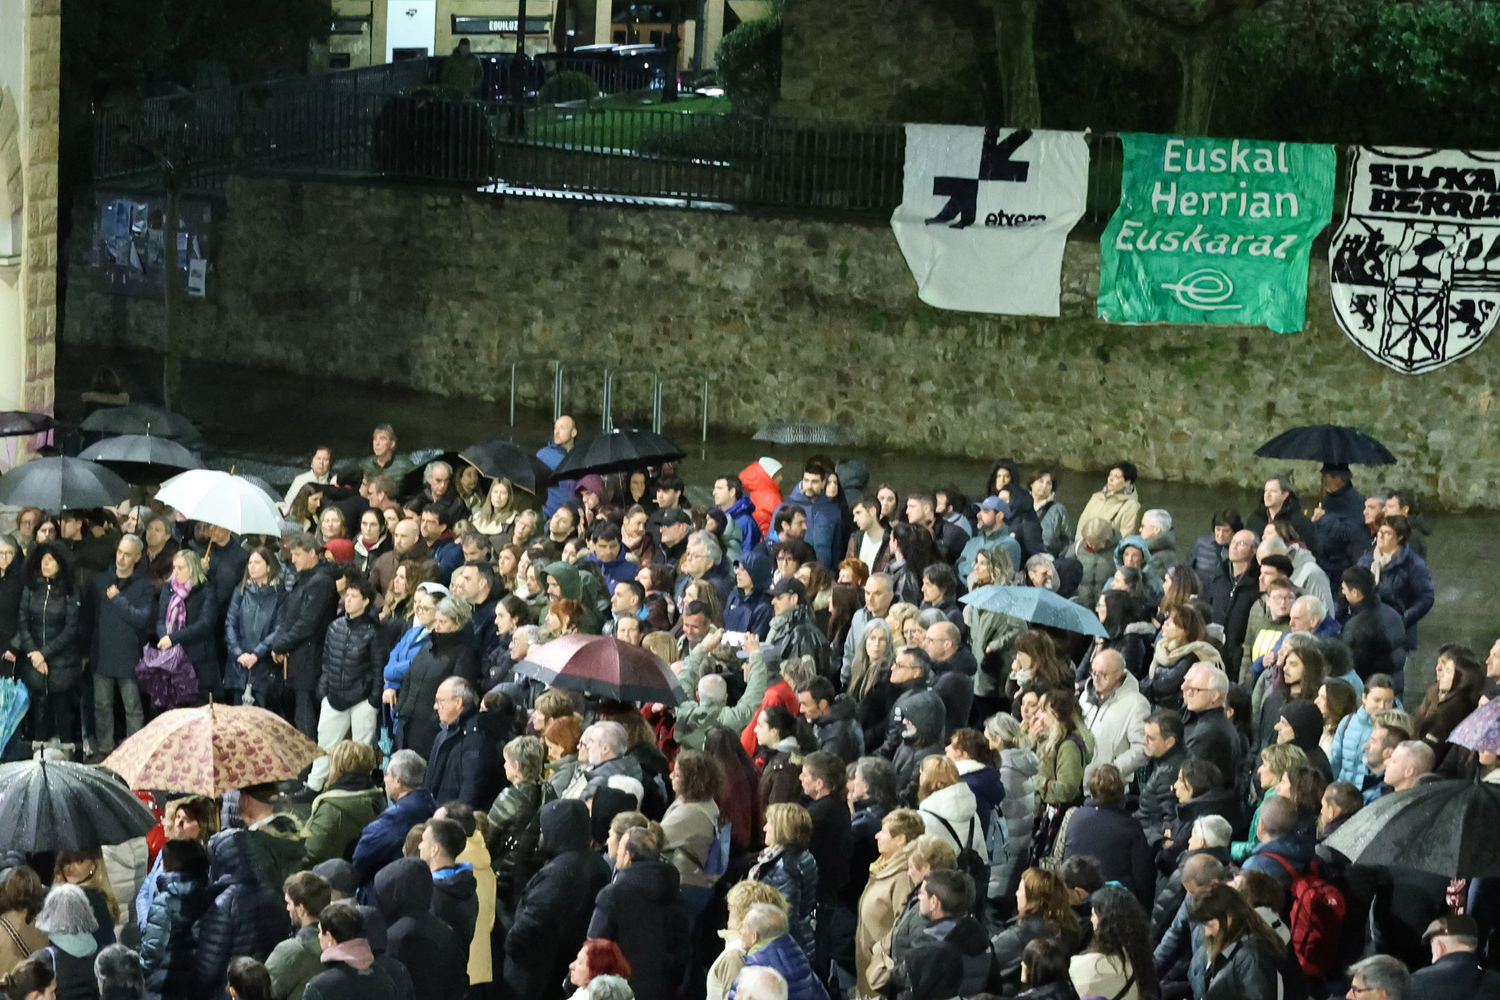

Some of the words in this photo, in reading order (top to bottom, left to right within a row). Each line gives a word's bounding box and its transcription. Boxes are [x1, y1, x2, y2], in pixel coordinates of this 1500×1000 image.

[1163, 139, 1289, 173] Euskal
[1369, 163, 1500, 193] EUSKA
[1152, 181, 1299, 218] Herrian
[1115, 219, 1298, 259] Euskaraz
